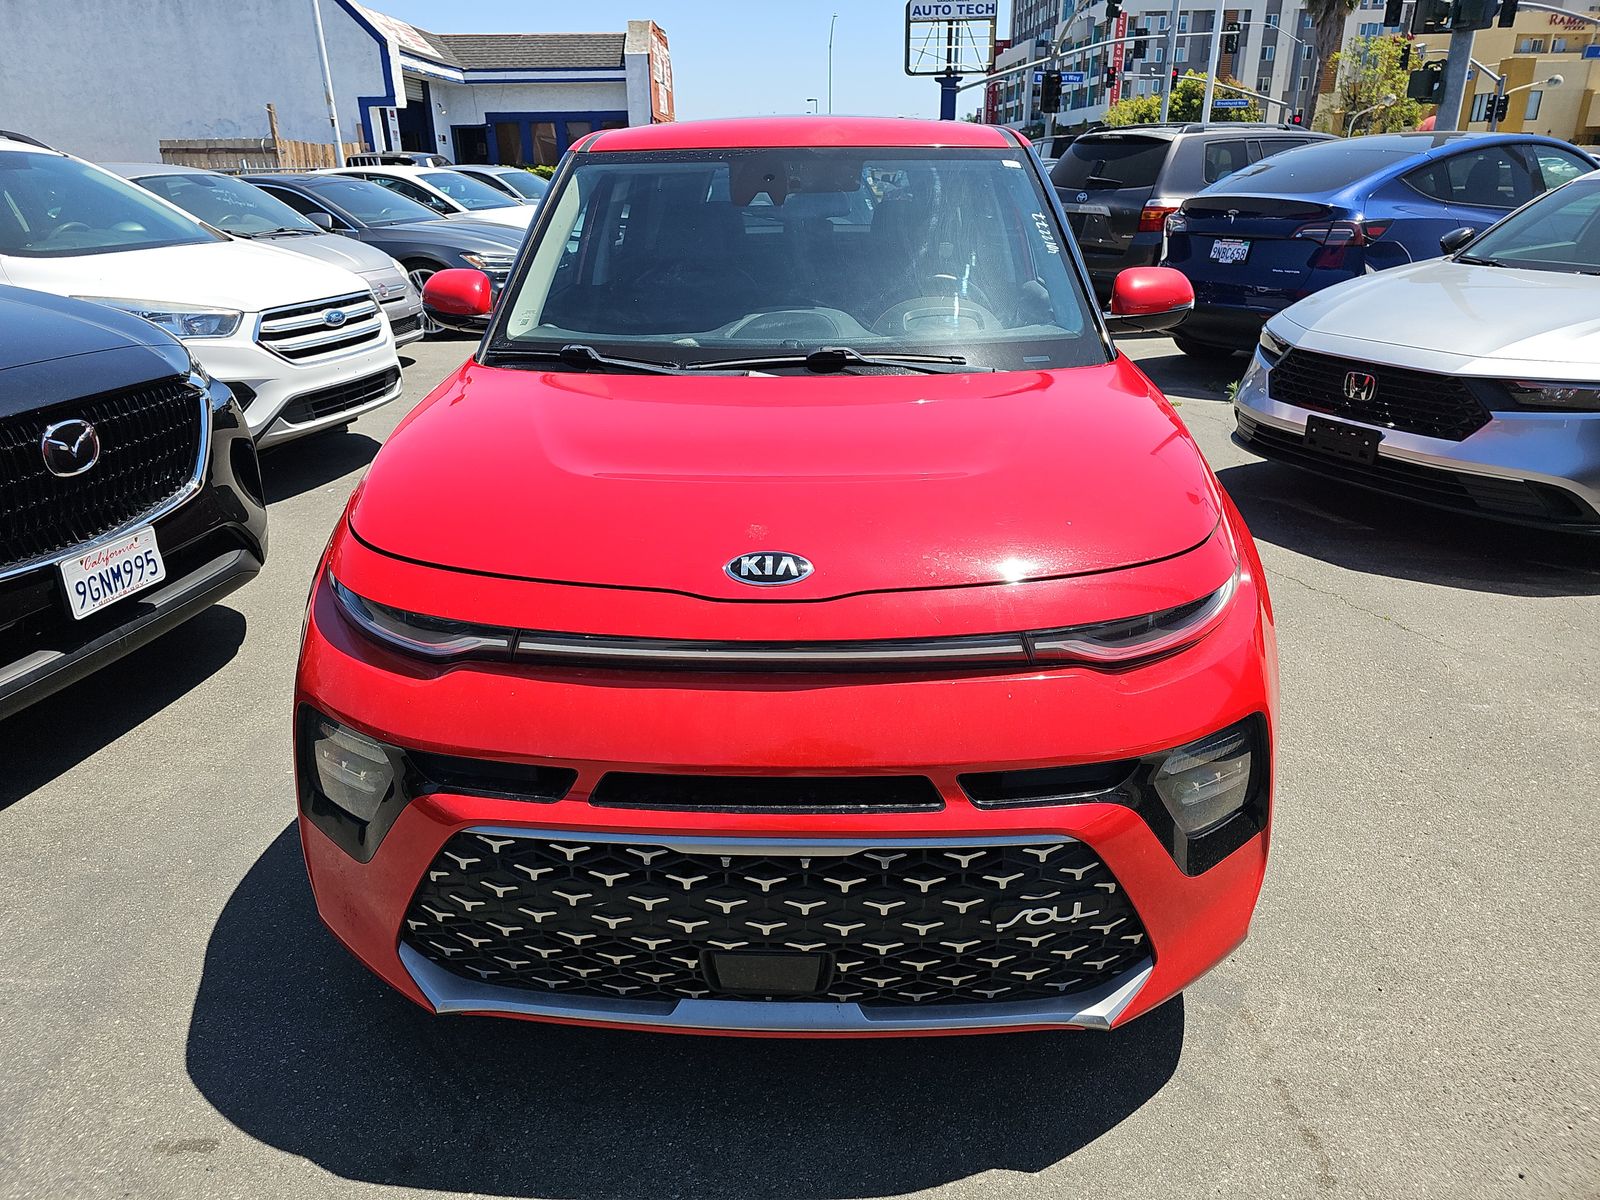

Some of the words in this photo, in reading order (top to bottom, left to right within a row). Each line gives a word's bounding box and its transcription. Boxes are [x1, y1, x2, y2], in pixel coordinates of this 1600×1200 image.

[912, 5, 952, 16] AUTO
[956, 4, 995, 15] TECH
[83, 543, 141, 571] California
[740, 555, 799, 576] KIA
[75, 549, 158, 609] 9GNM995
